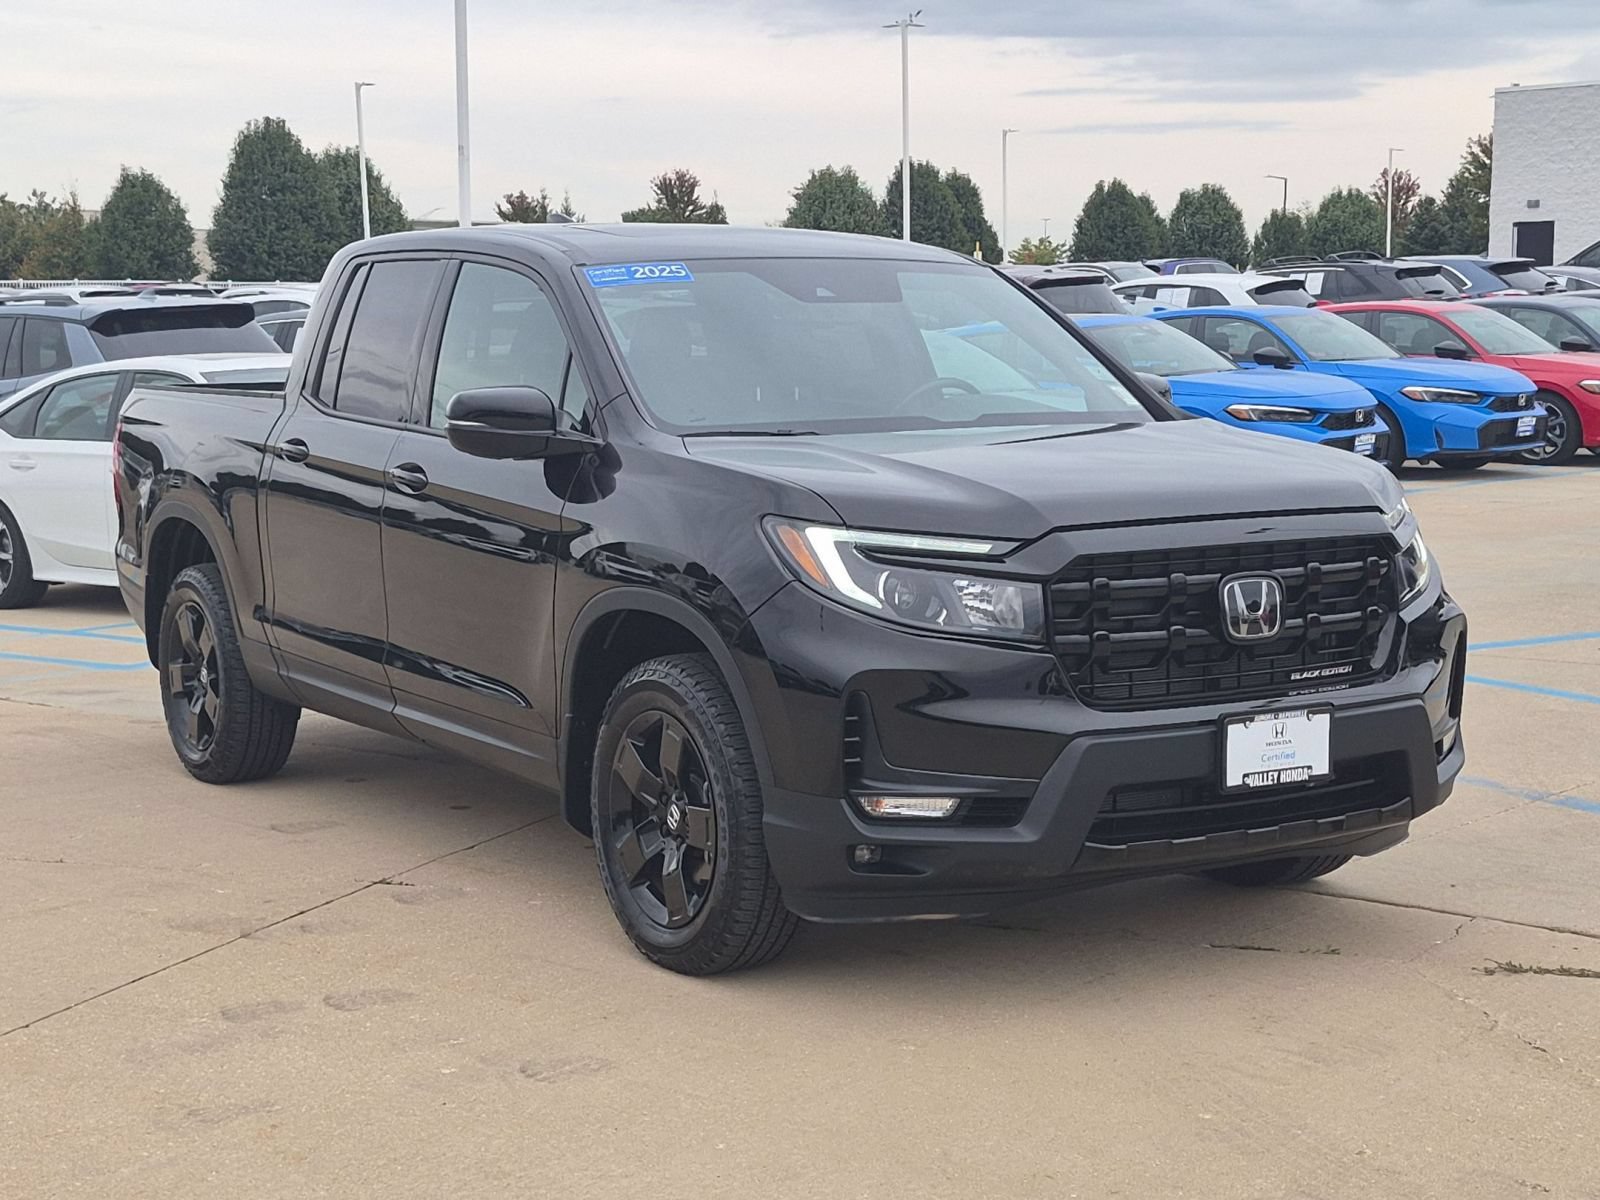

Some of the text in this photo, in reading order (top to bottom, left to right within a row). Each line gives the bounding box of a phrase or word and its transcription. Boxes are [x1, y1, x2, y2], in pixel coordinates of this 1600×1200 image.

[631, 265, 686, 278] 2025
[1291, 665, 1353, 680] BLACK EDITION
[1265, 739, 1293, 747] HONDA
[1261, 750, 1296, 762] Certified
[1249, 767, 1309, 787] VALLEY HONDA
